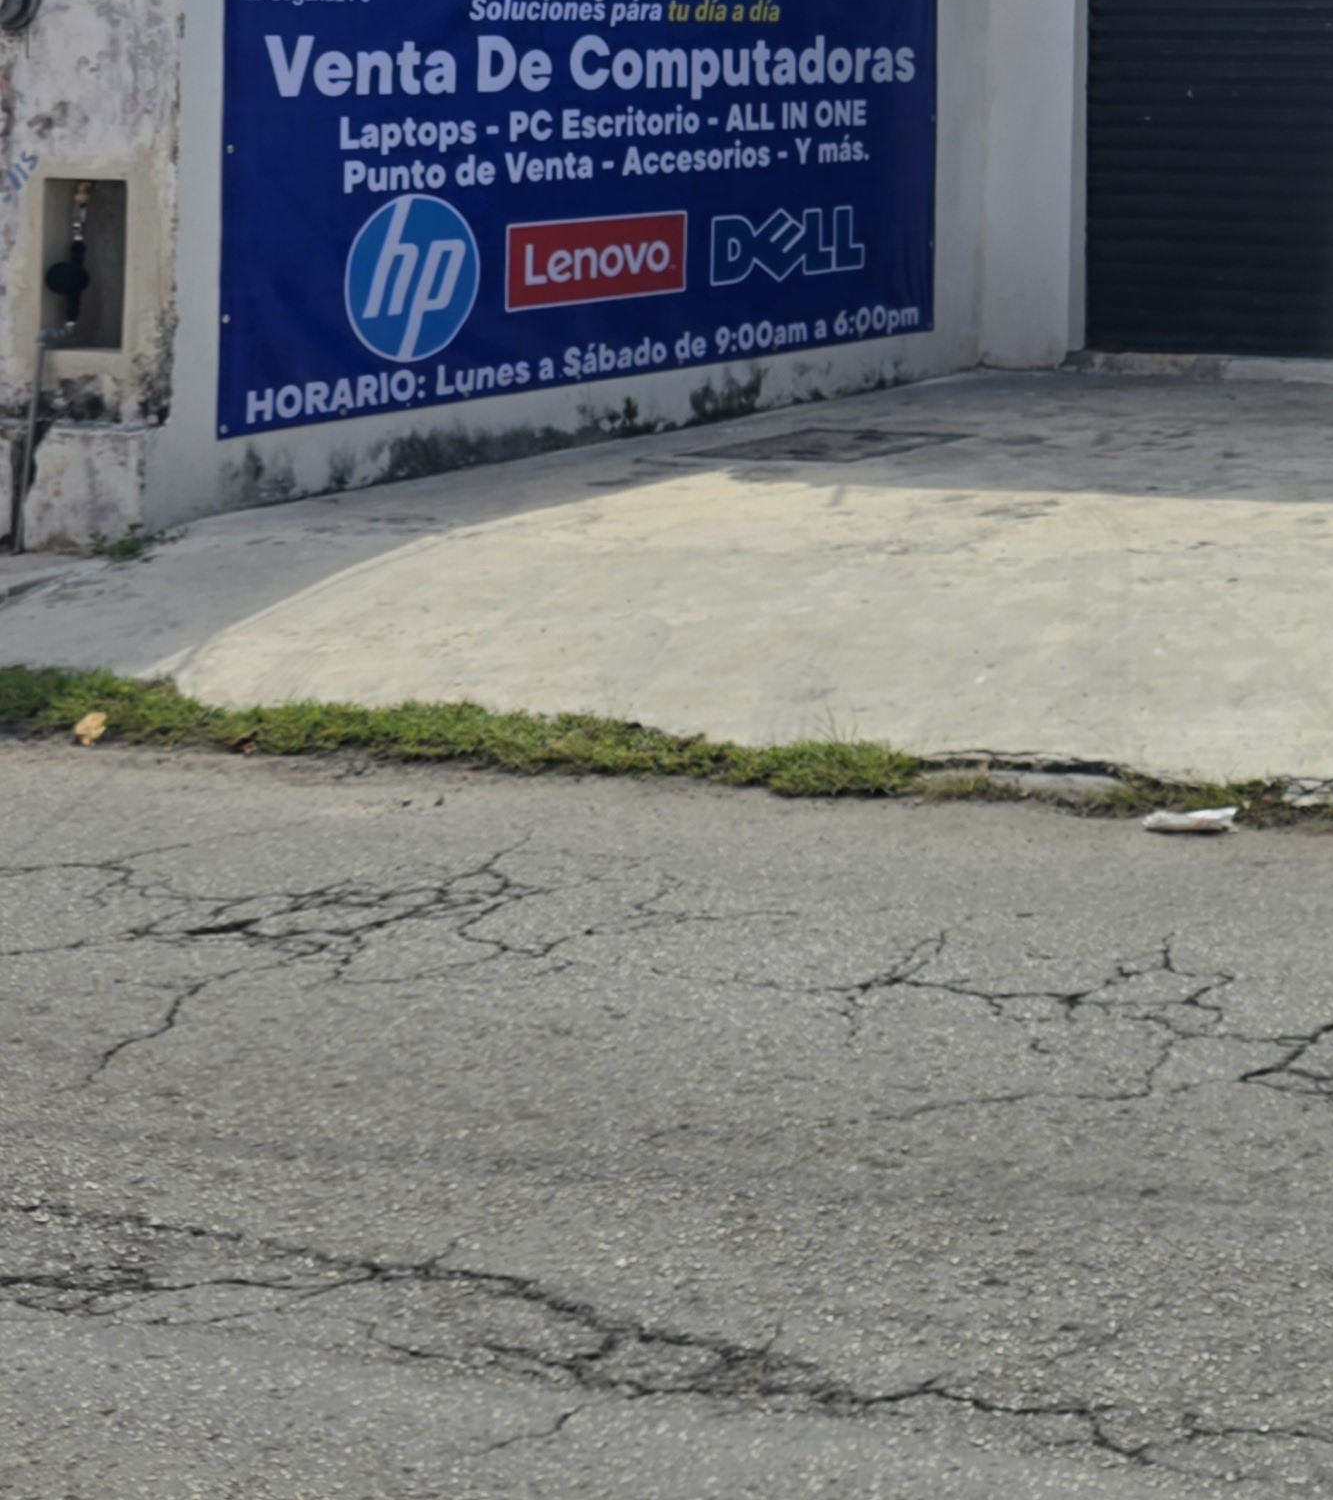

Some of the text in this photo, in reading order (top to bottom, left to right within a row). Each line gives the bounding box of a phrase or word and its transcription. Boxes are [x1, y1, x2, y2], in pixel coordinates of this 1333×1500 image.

[610, 2, 663, 27] para
[668, 0, 690, 21] tu
[694, 0, 727, 21] día
[748, 0, 781, 22] día
[264, 34, 916, 100] Venta De Computadoras
[340, 99, 867, 155] Laptops PC Escritorio ALL IN ONE
[343, 134, 870, 194] Punto de Venta Accesorios más.
[524, 240, 671, 286] Lenovo
[710, 205, 865, 286] DELL
[362, 196, 466, 361] hp
[246, 305, 919, 424] HORARIO: Lunes Sábado de 9:00am 6:00pm
